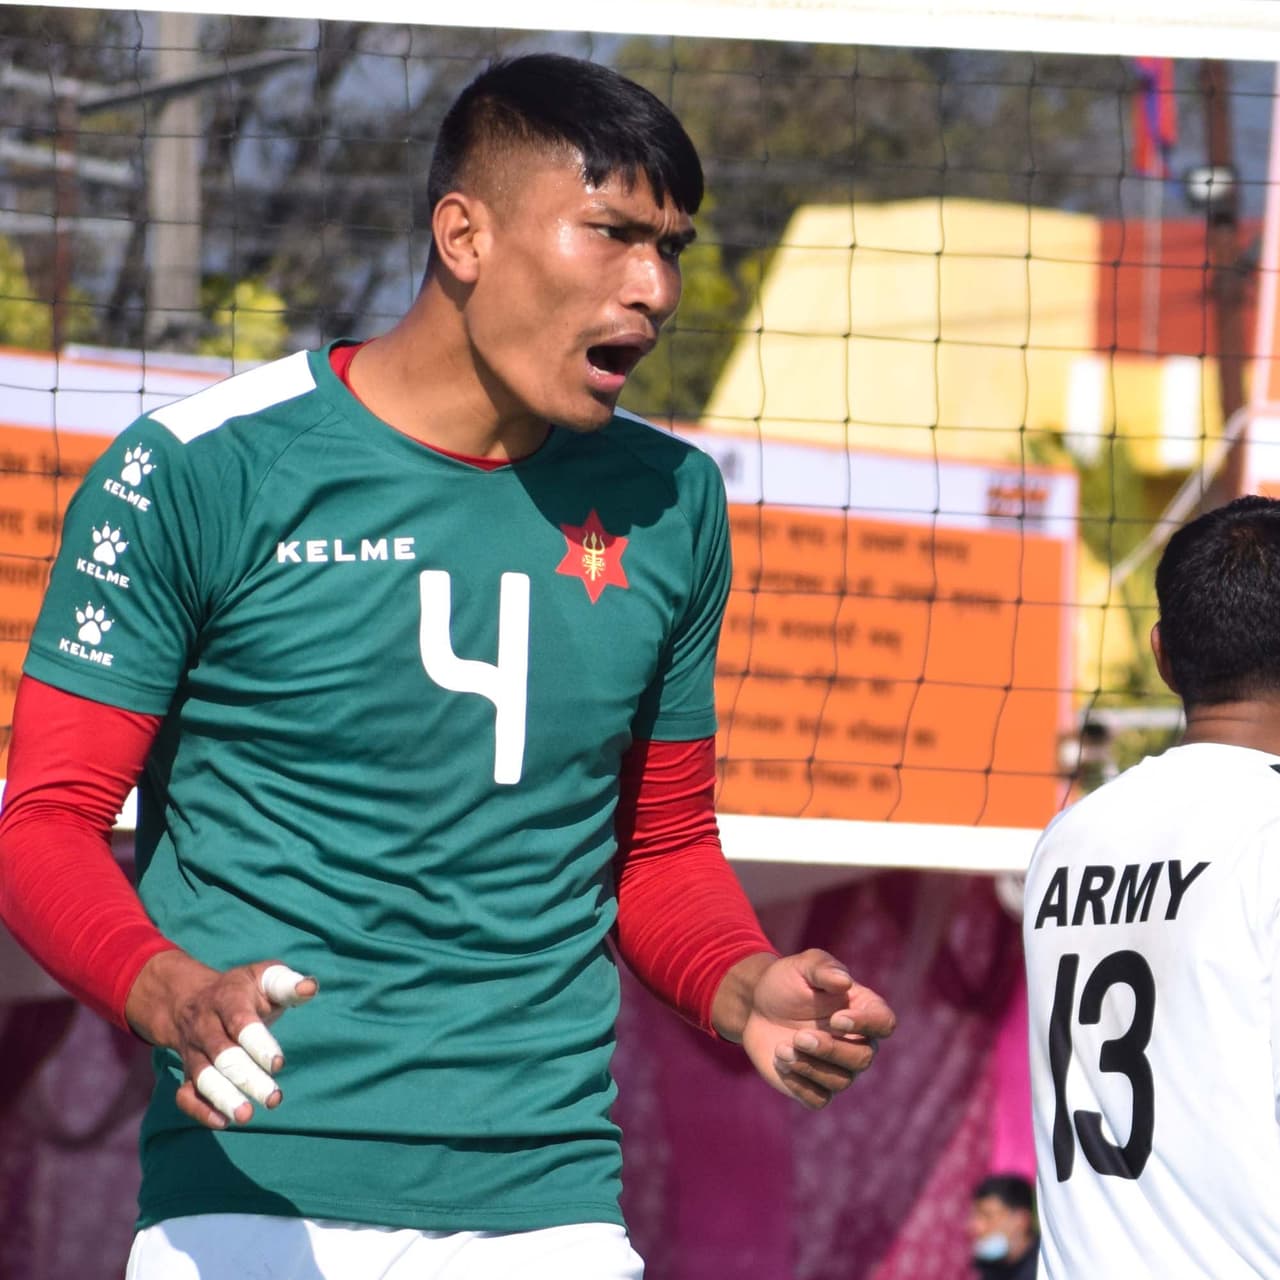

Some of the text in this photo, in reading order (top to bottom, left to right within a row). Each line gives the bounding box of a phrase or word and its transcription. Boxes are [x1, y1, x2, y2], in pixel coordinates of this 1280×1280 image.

[104, 478, 152, 512] KELME
[277, 537, 416, 564] KELME
[76, 558, 130, 588] KELME
[59, 638, 114, 667] KELME
[419, 569, 532, 785] 4
[1034, 859, 1211, 930] ARMY
[1048, 950, 1156, 1183] 13
